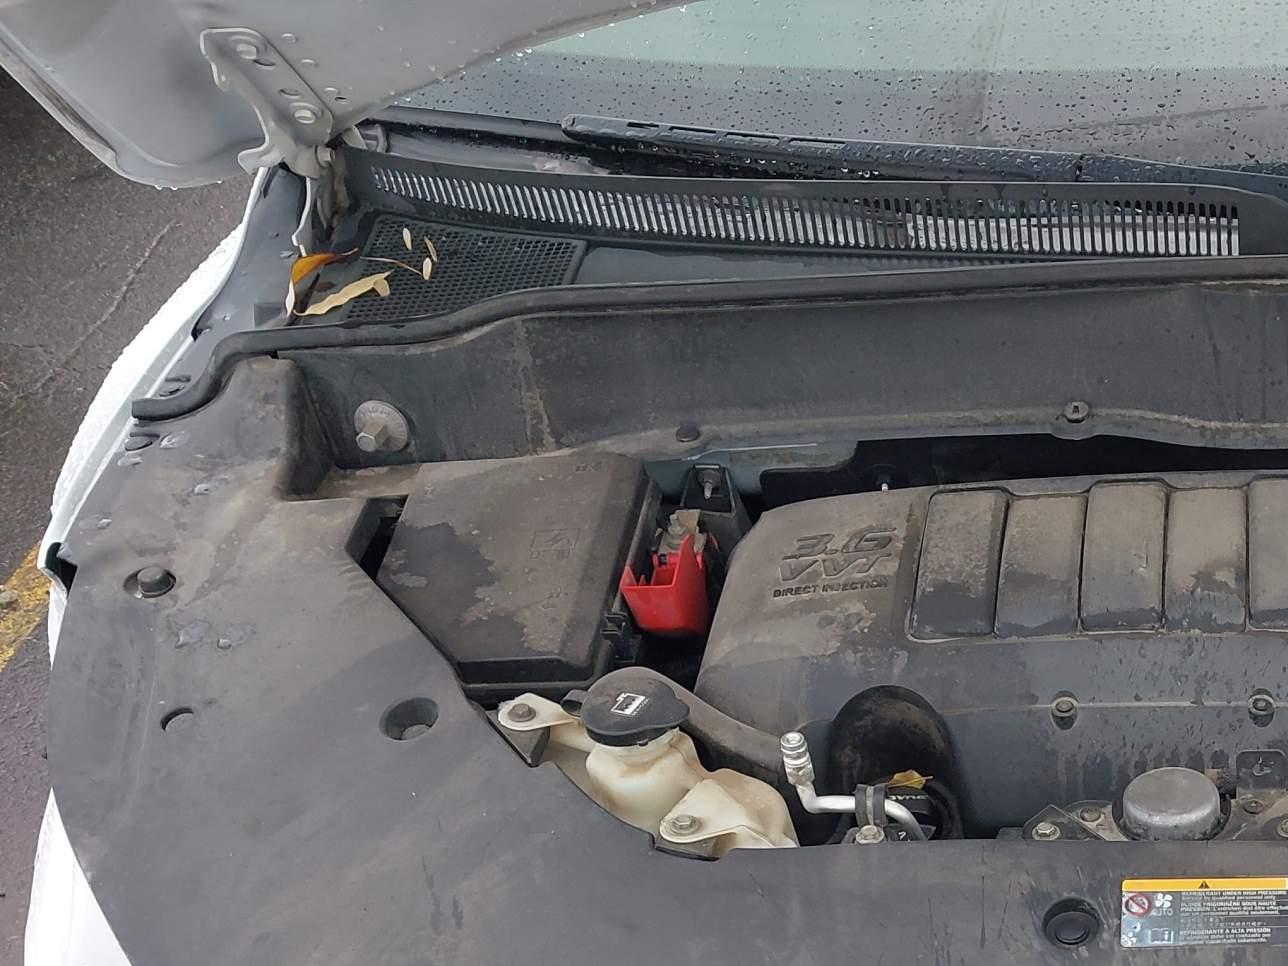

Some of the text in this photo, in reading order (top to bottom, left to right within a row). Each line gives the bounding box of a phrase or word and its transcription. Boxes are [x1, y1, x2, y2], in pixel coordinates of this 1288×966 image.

[797, 527, 896, 557] 3.6
[780, 552, 892, 582] VVT
[773, 579, 888, 598] DIRECT INJECTION
